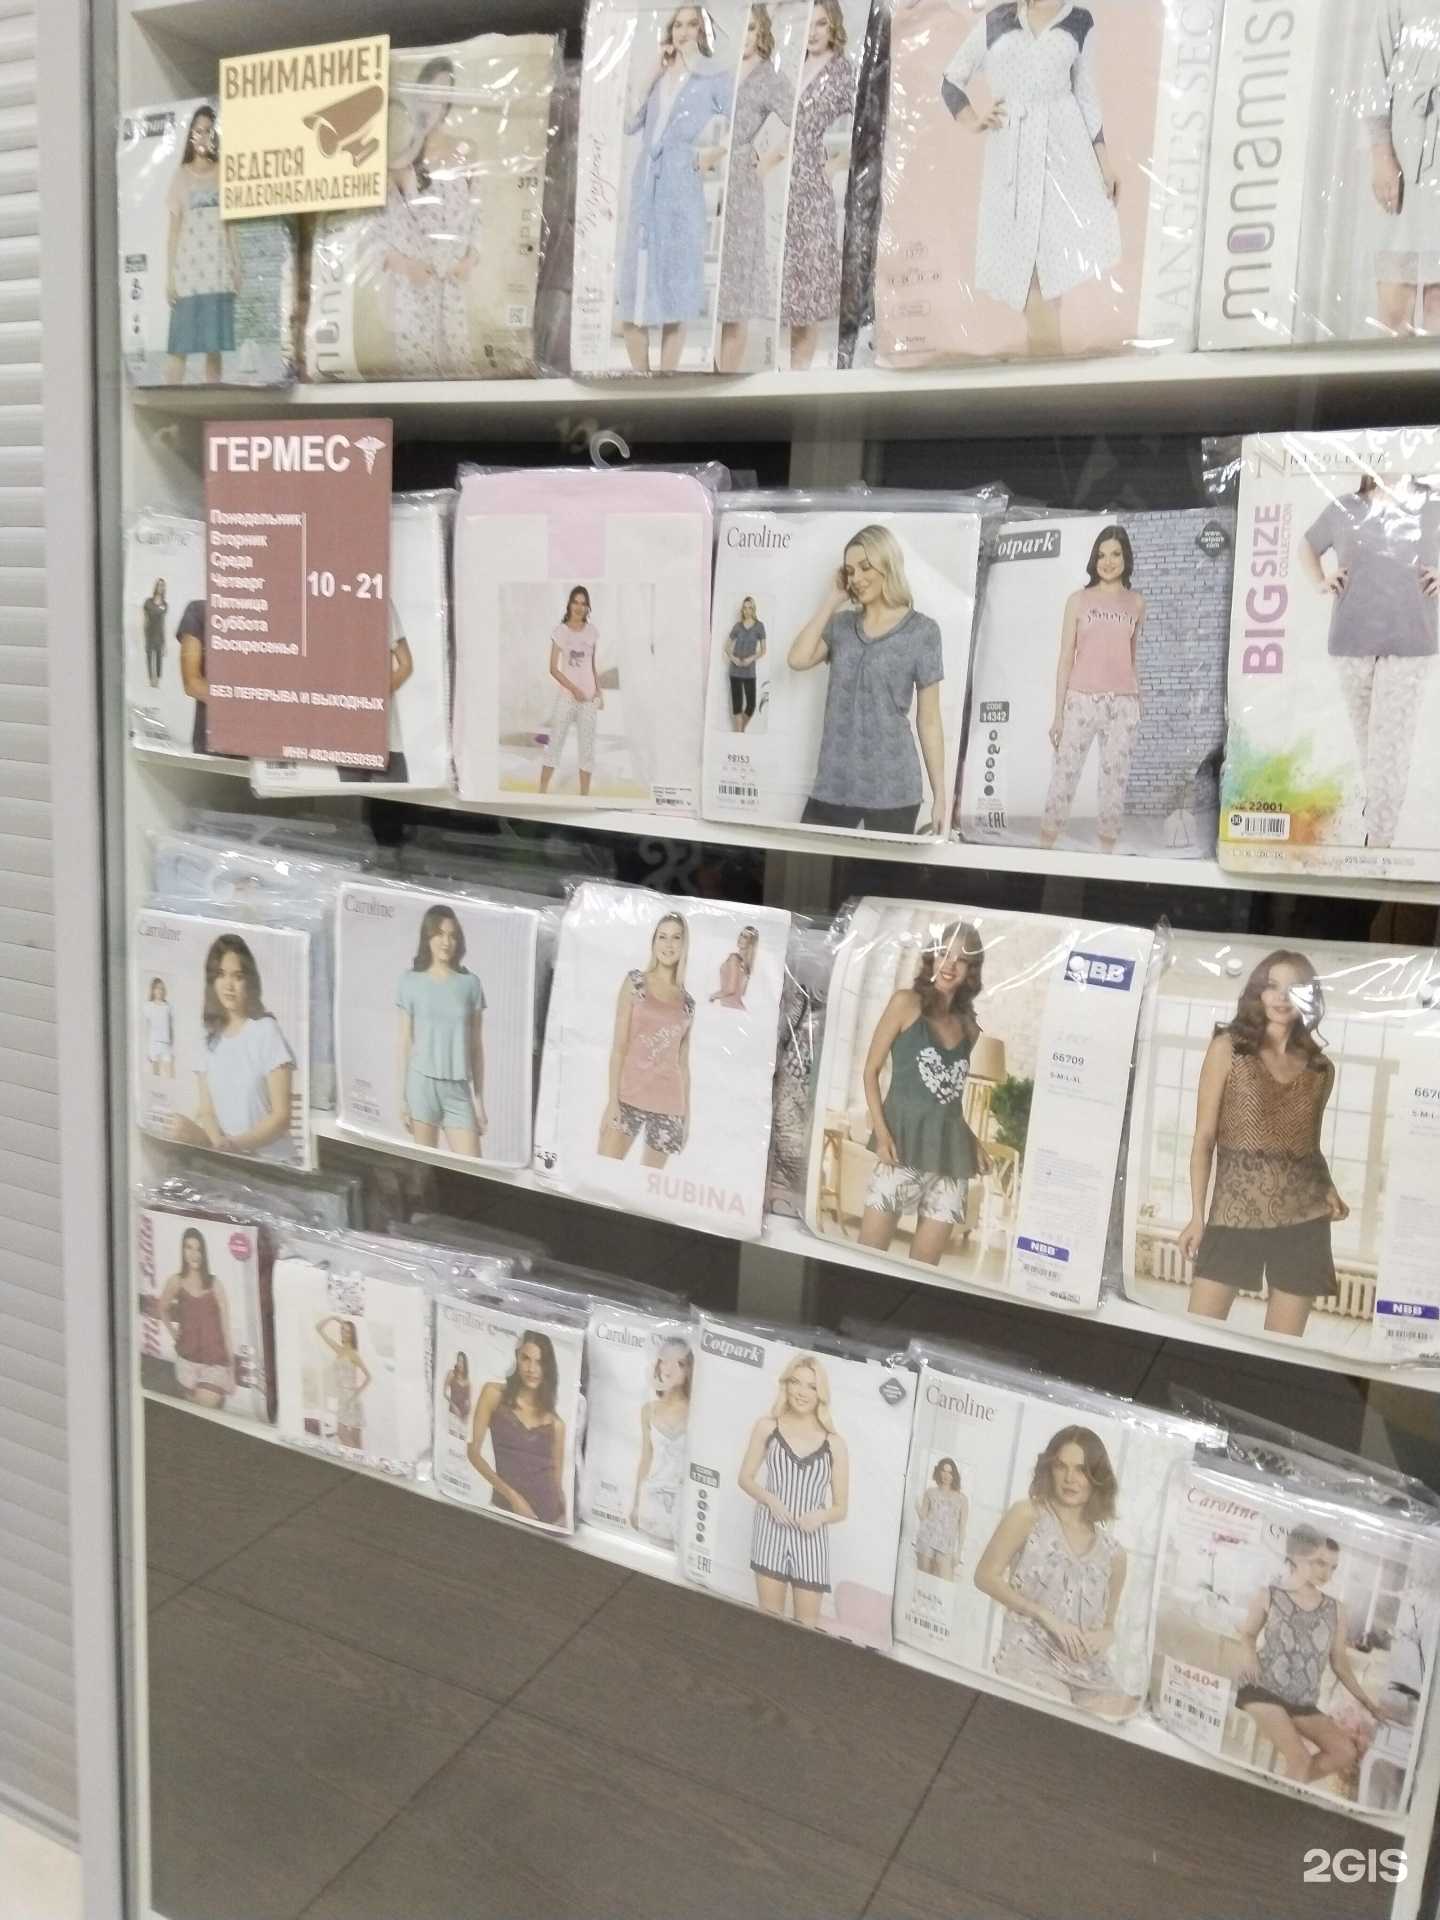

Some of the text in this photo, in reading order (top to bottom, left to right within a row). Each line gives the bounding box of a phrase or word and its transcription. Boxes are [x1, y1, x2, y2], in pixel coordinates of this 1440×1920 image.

[1175, 0, 1214, 93] SEC
[225, 45, 383, 100] ВНИМАНИЕ!
[225, 145, 304, 183] ВЕДЕТСЯ
[1222, 0, 1294, 320] monamis
[225, 172, 381, 209] ВИДЕОНАБЛЮДЕНИЕ
[209, 434, 350, 472] ГЕРМЕС
[210, 509, 303, 527] Понедельник
[210, 530, 268, 549] Вторник
[727, 524, 791, 548] Caroline
[994, 531, 1056, 560] otpark
[1250, 503, 1281, 578] SIZE
[210, 552, 254, 570] Среда
[210, 573, 266, 592] Четверг
[307, 571, 335, 597] 10
[356, 572, 383, 599] 21
[211, 594, 268, 612] Пятница
[211, 614, 268, 633] Суббота
[1242, 584, 1289, 674] BIG
[211, 635, 298, 655] Воскресенье
[209, 684, 385, 711] БЕЗ ПЕРЕРЫВА И ВЫХОДНЫХ
[1030, 1240, 1056, 1256] NBB
[1392, 1303, 1423, 1316] NBB
[704, 1333, 760, 1361] Cotpark
[926, 1385, 994, 1421] Caroline
[1187, 1487, 1259, 1520] Caroline
